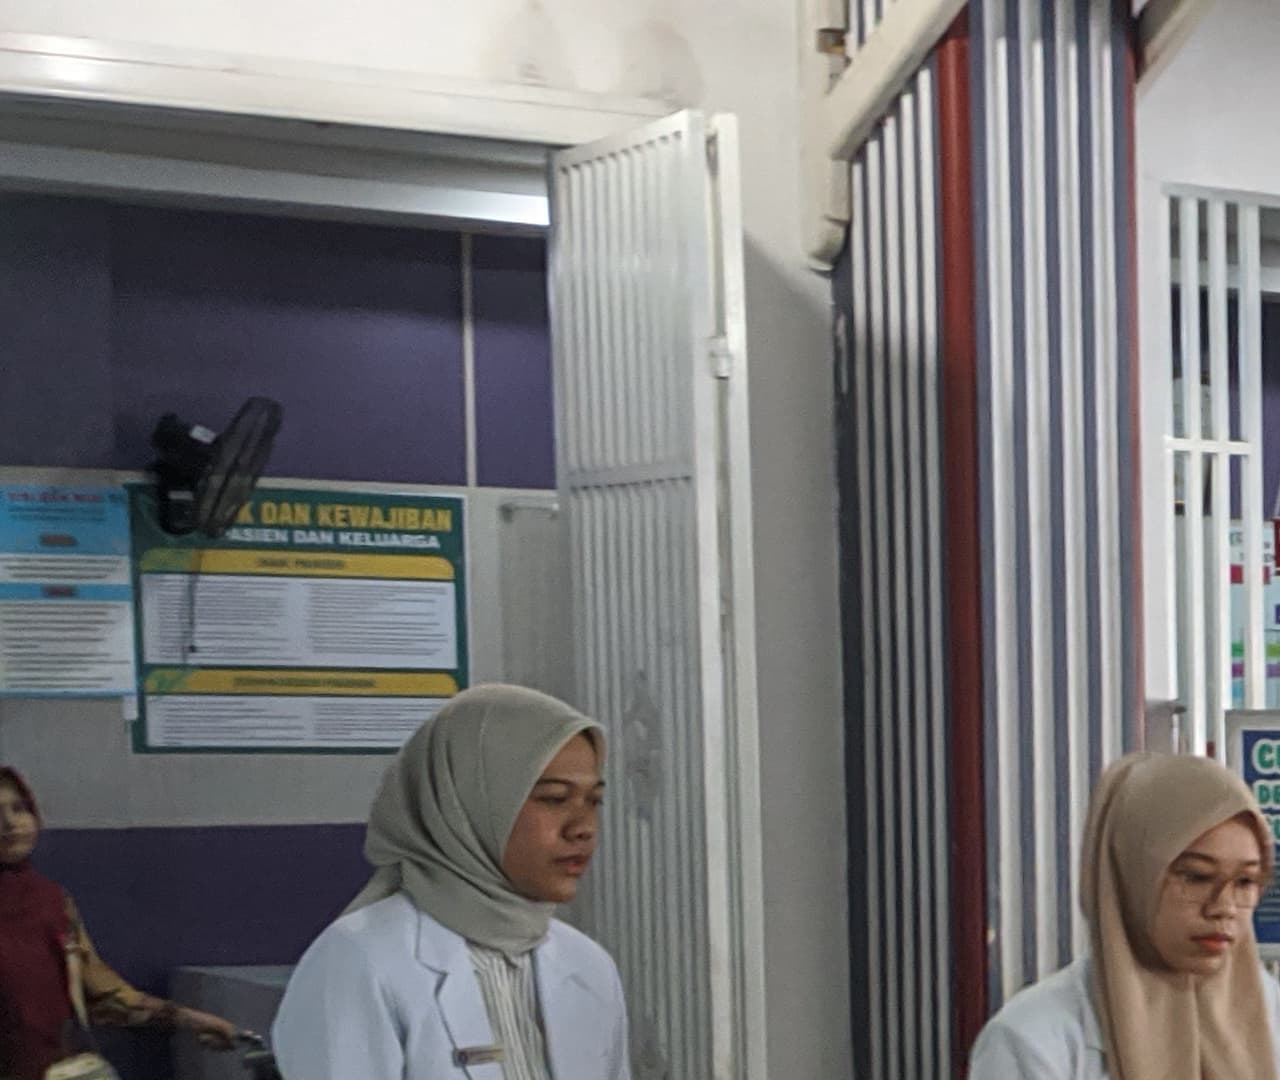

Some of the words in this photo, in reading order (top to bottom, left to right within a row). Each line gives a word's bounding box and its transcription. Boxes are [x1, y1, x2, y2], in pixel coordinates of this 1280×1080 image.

[261, 501, 310, 526] DAN
[317, 504, 453, 532] KEWAJIBAN
[225, 528, 289, 543] ASIEN
[293, 530, 335, 545] DAN
[338, 531, 441, 549] KELUARGA
